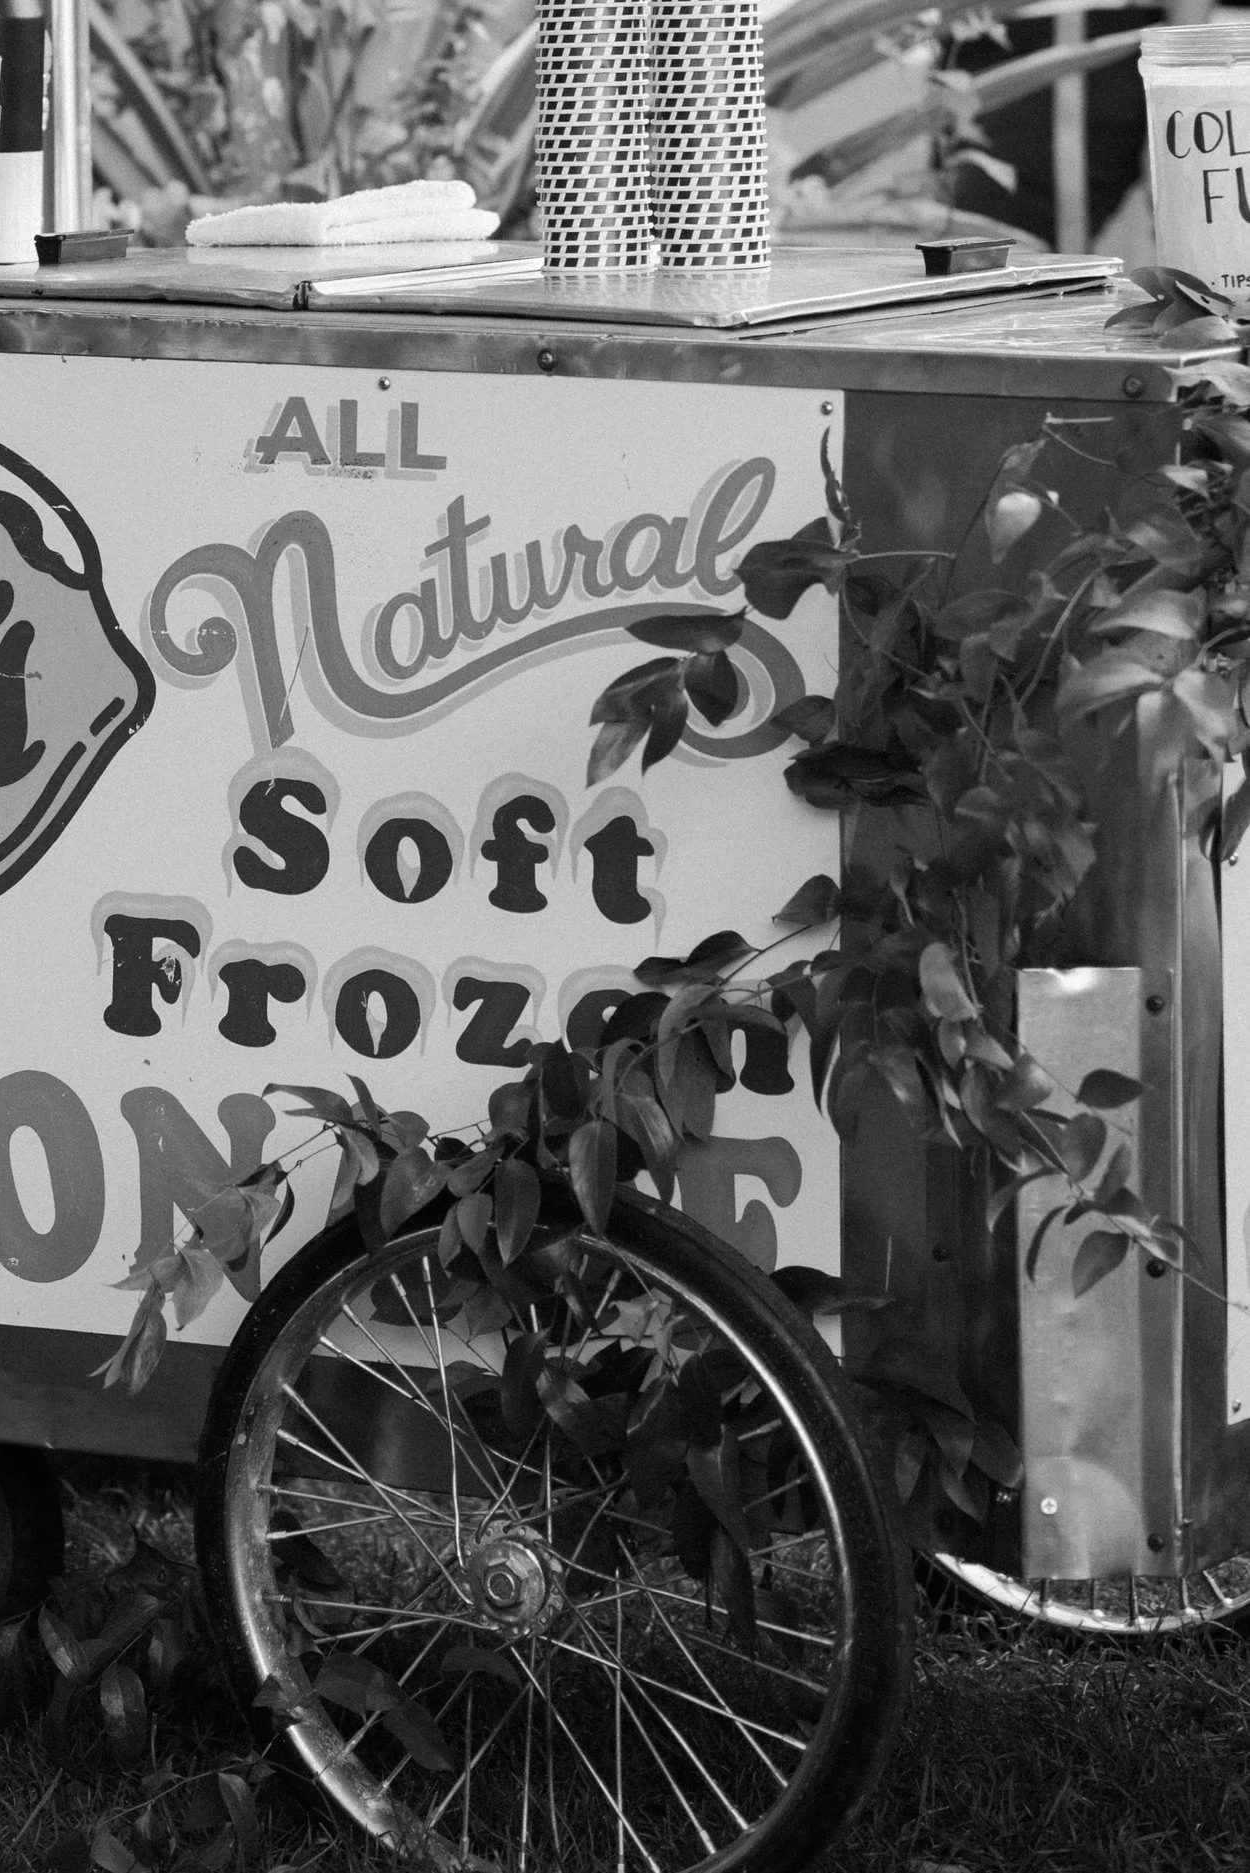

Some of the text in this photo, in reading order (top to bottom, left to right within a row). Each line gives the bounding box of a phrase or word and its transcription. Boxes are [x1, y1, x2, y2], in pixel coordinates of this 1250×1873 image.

[249, 396, 447, 476] ALL
[143, 456, 790, 753] Natural
[228, 768, 659, 925] Soft
